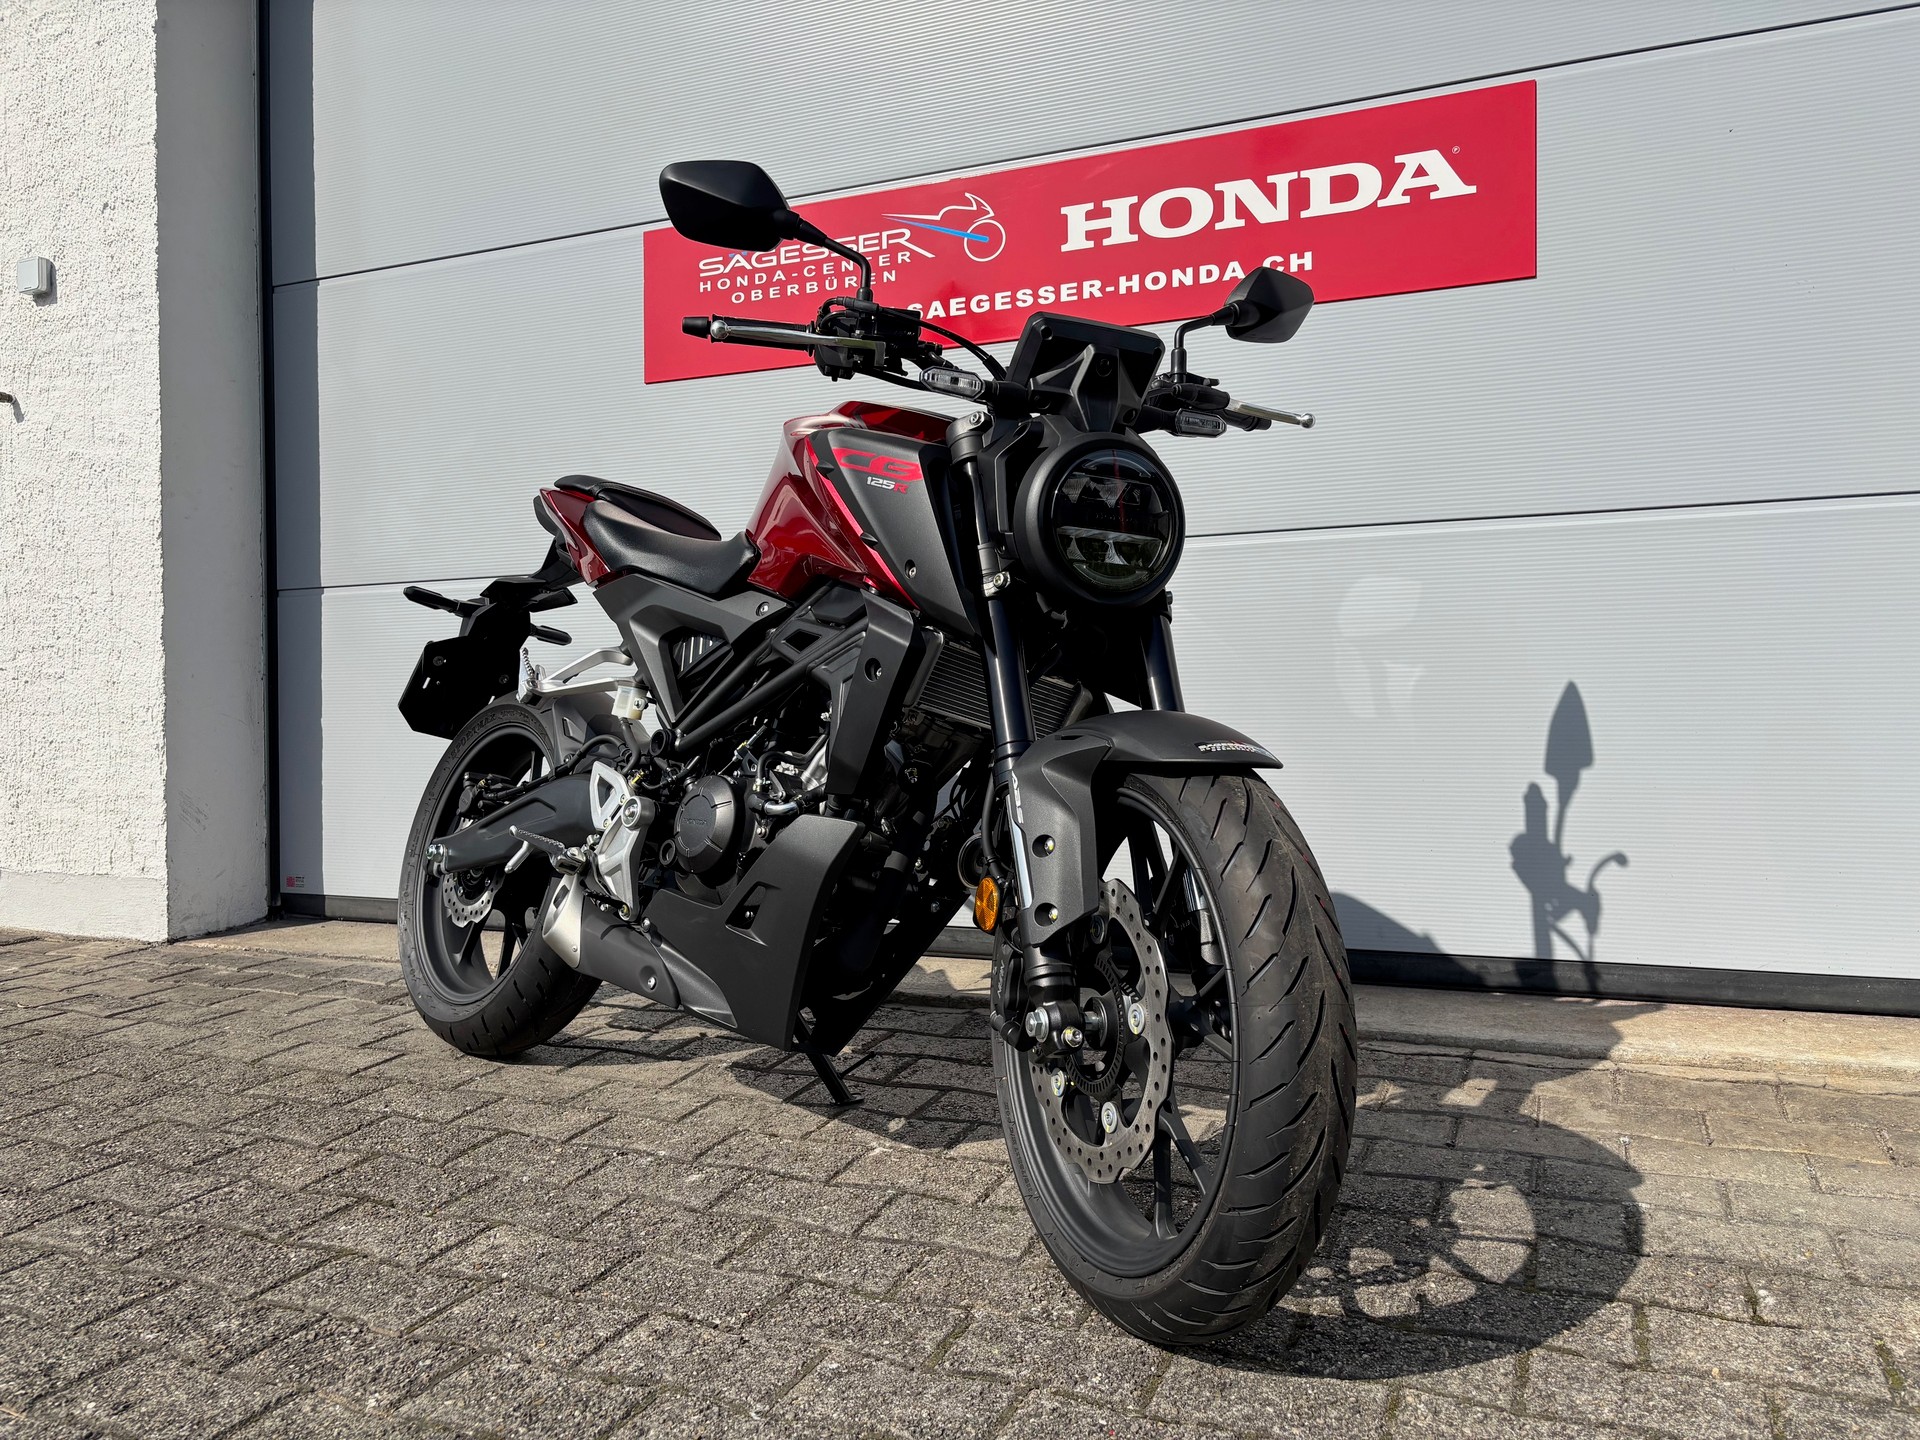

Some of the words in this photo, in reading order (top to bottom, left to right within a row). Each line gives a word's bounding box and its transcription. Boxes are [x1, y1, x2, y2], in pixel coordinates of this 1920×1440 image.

[1061, 148, 1477, 253] HONDA
[699, 251, 911, 293] HONDA-CENER
[906, 251, 1313, 320] AEGESSER-HONDACH
[866, 476, 908, 494] 125R
